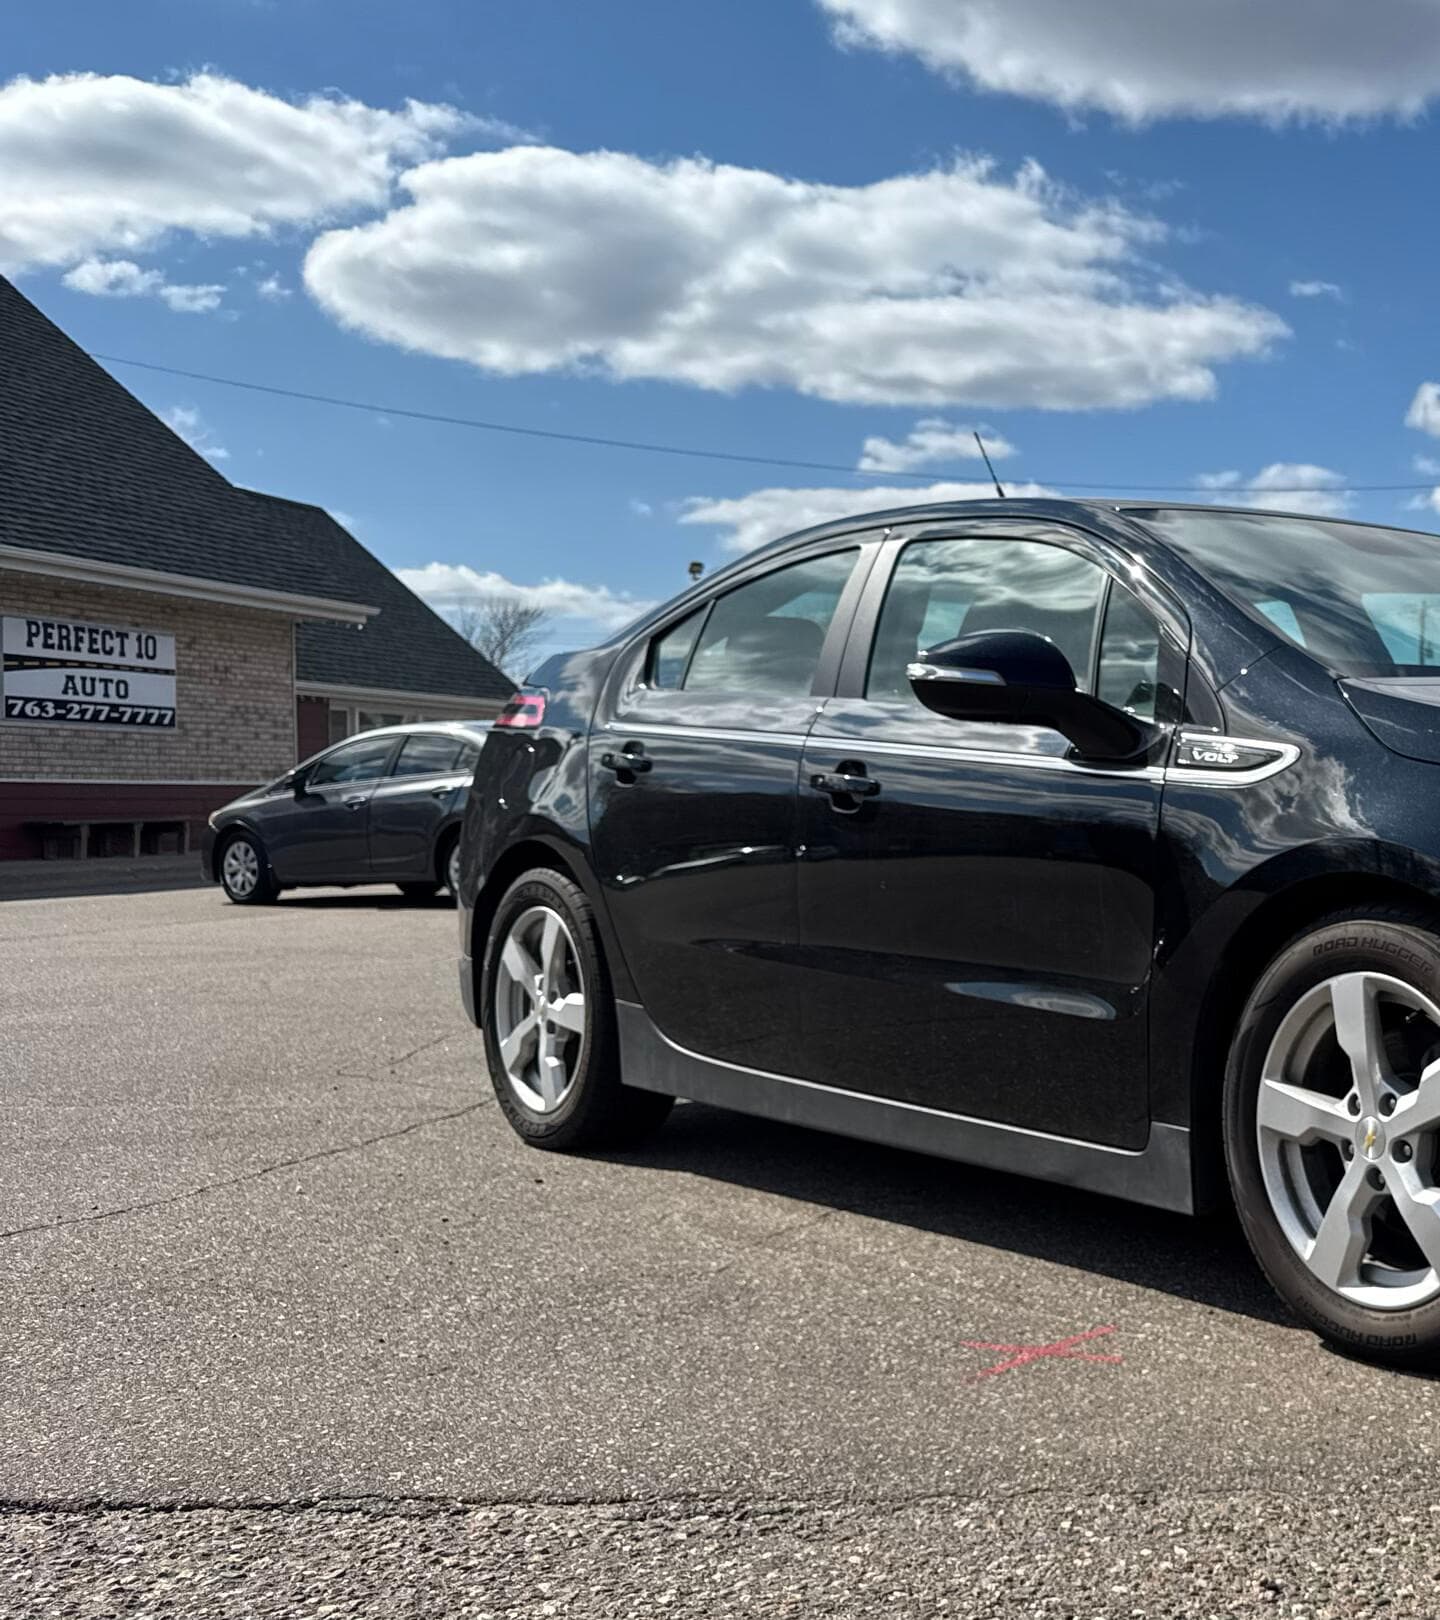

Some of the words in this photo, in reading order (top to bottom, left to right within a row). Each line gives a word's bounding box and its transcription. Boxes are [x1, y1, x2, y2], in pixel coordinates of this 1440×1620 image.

[26, 620, 129, 657] PERFECT
[135, 634, 157, 661] 10
[61, 674, 129, 700] AUTO
[8, 699, 173, 725] 763-277-7777
[1192, 748, 1239, 764] VOLT
[1313, 936, 1359, 956] ROAD
[1361, 937, 1434, 974] HUGGER
